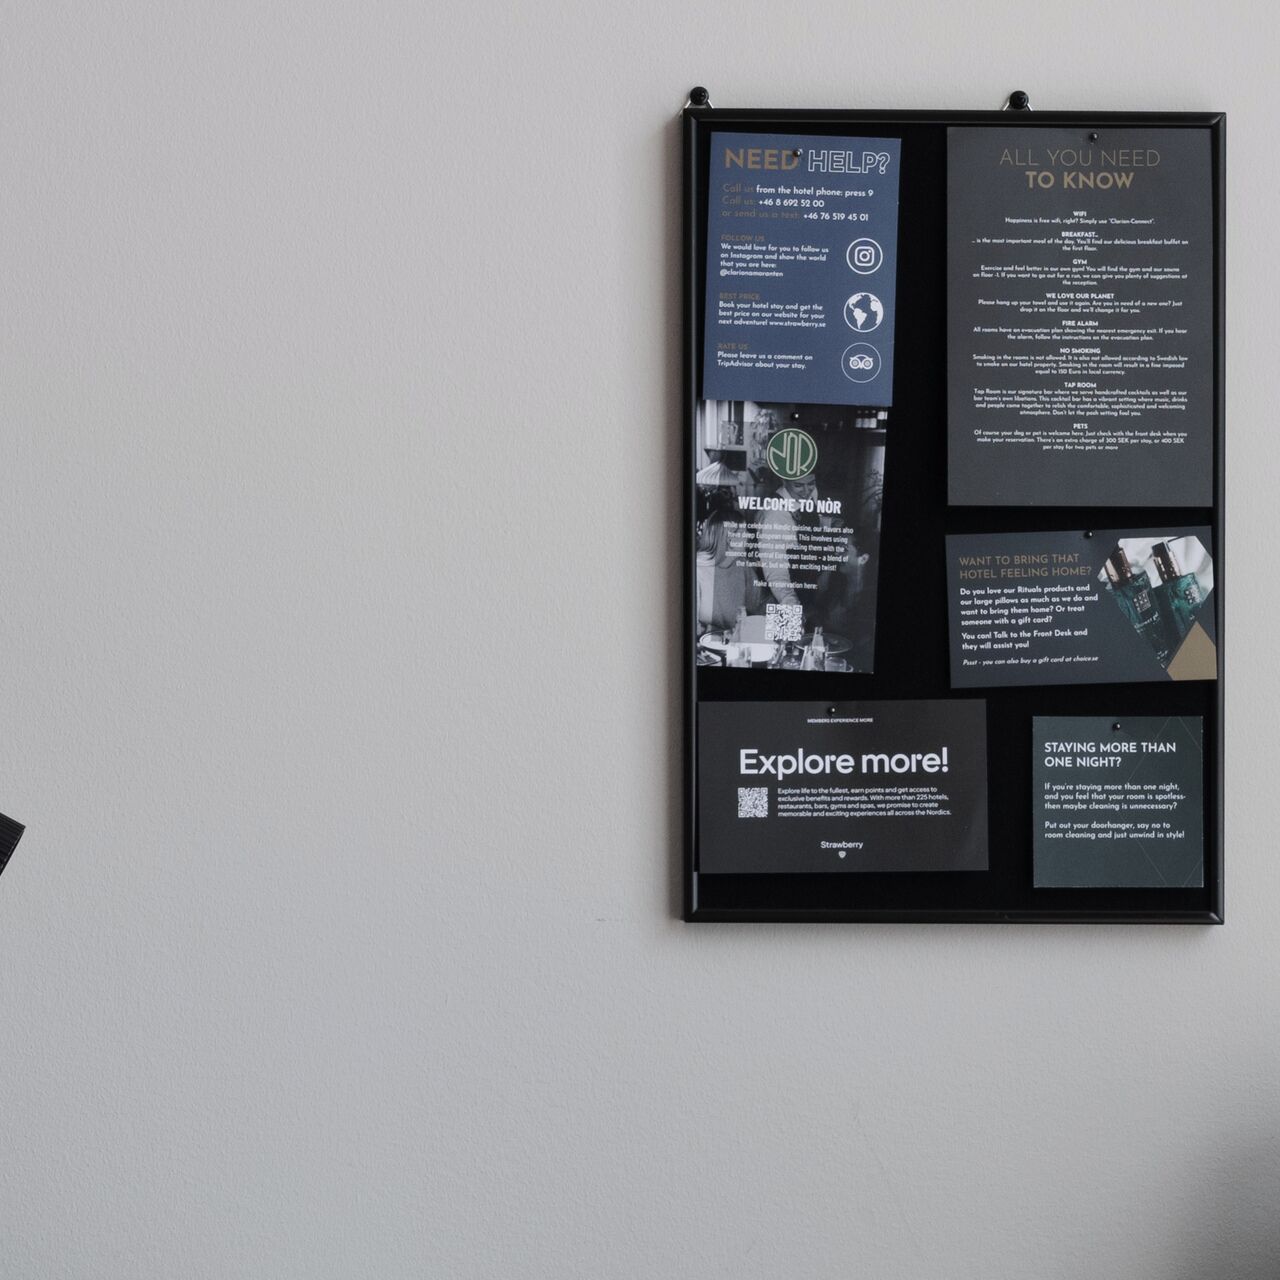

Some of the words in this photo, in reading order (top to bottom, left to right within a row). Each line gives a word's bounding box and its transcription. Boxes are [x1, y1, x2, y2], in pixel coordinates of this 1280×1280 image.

[724, 148, 799, 170] NEED
[808, 149, 890, 174] HELP?
[1000, 148, 1040, 166] ALL
[1047, 149, 1092, 167] YOU
[1101, 149, 1160, 167] NEED
[1026, 171, 1055, 189] TO
[1064, 172, 1134, 189] KNOW
[756, 185, 776, 194] from
[778, 186, 791, 194] the
[793, 186, 814, 195] hotel
[816, 188, 843, 197] phone:
[738, 496, 795, 511] WELCOME
[800, 497, 814, 512] TO
[817, 497, 841, 514] NÒR
[959, 556, 992, 566] WANT
[995, 556, 1010, 565] TO
[1014, 554, 1049, 565] BRING
[1052, 553, 1079, 563] THAT
[960, 569, 997, 579] HOTEL
[1001, 568, 1049, 578] FEELING
[1052, 566, 1092, 576] HOME?
[1044, 585, 1075, 594] products
[974, 598, 993, 606] large
[995, 597, 1019, 606] pillows
[1084, 594, 1098, 602] and
[990, 607, 1009, 616] bring
[1018, 617, 1031, 625] gift
[1045, 742, 1096, 753] STAYING
[1100, 742, 1137, 753] MORE
[1141, 742, 1176, 753] THAN
[740, 748, 855, 781] Explore
[862, 747, 948, 773] more!
[1045, 757, 1072, 767] ONE
[1077, 757, 1122, 767] NIGHT?
[1052, 783, 1074, 791] you're
[1076, 784, 1102, 793] staying
[1159, 783, 1180, 792] night,
[1063, 802, 1088, 811] maybe
[1089, 802, 1120, 811] cleaning
[1130, 802, 1178, 811] unnecessary?
[1091, 822, 1135, 830] doorhanger,
[1065, 831, 1096, 840] cleaning
[1166, 831, 1185, 840] style!
[821, 841, 864, 849] Strawberry
